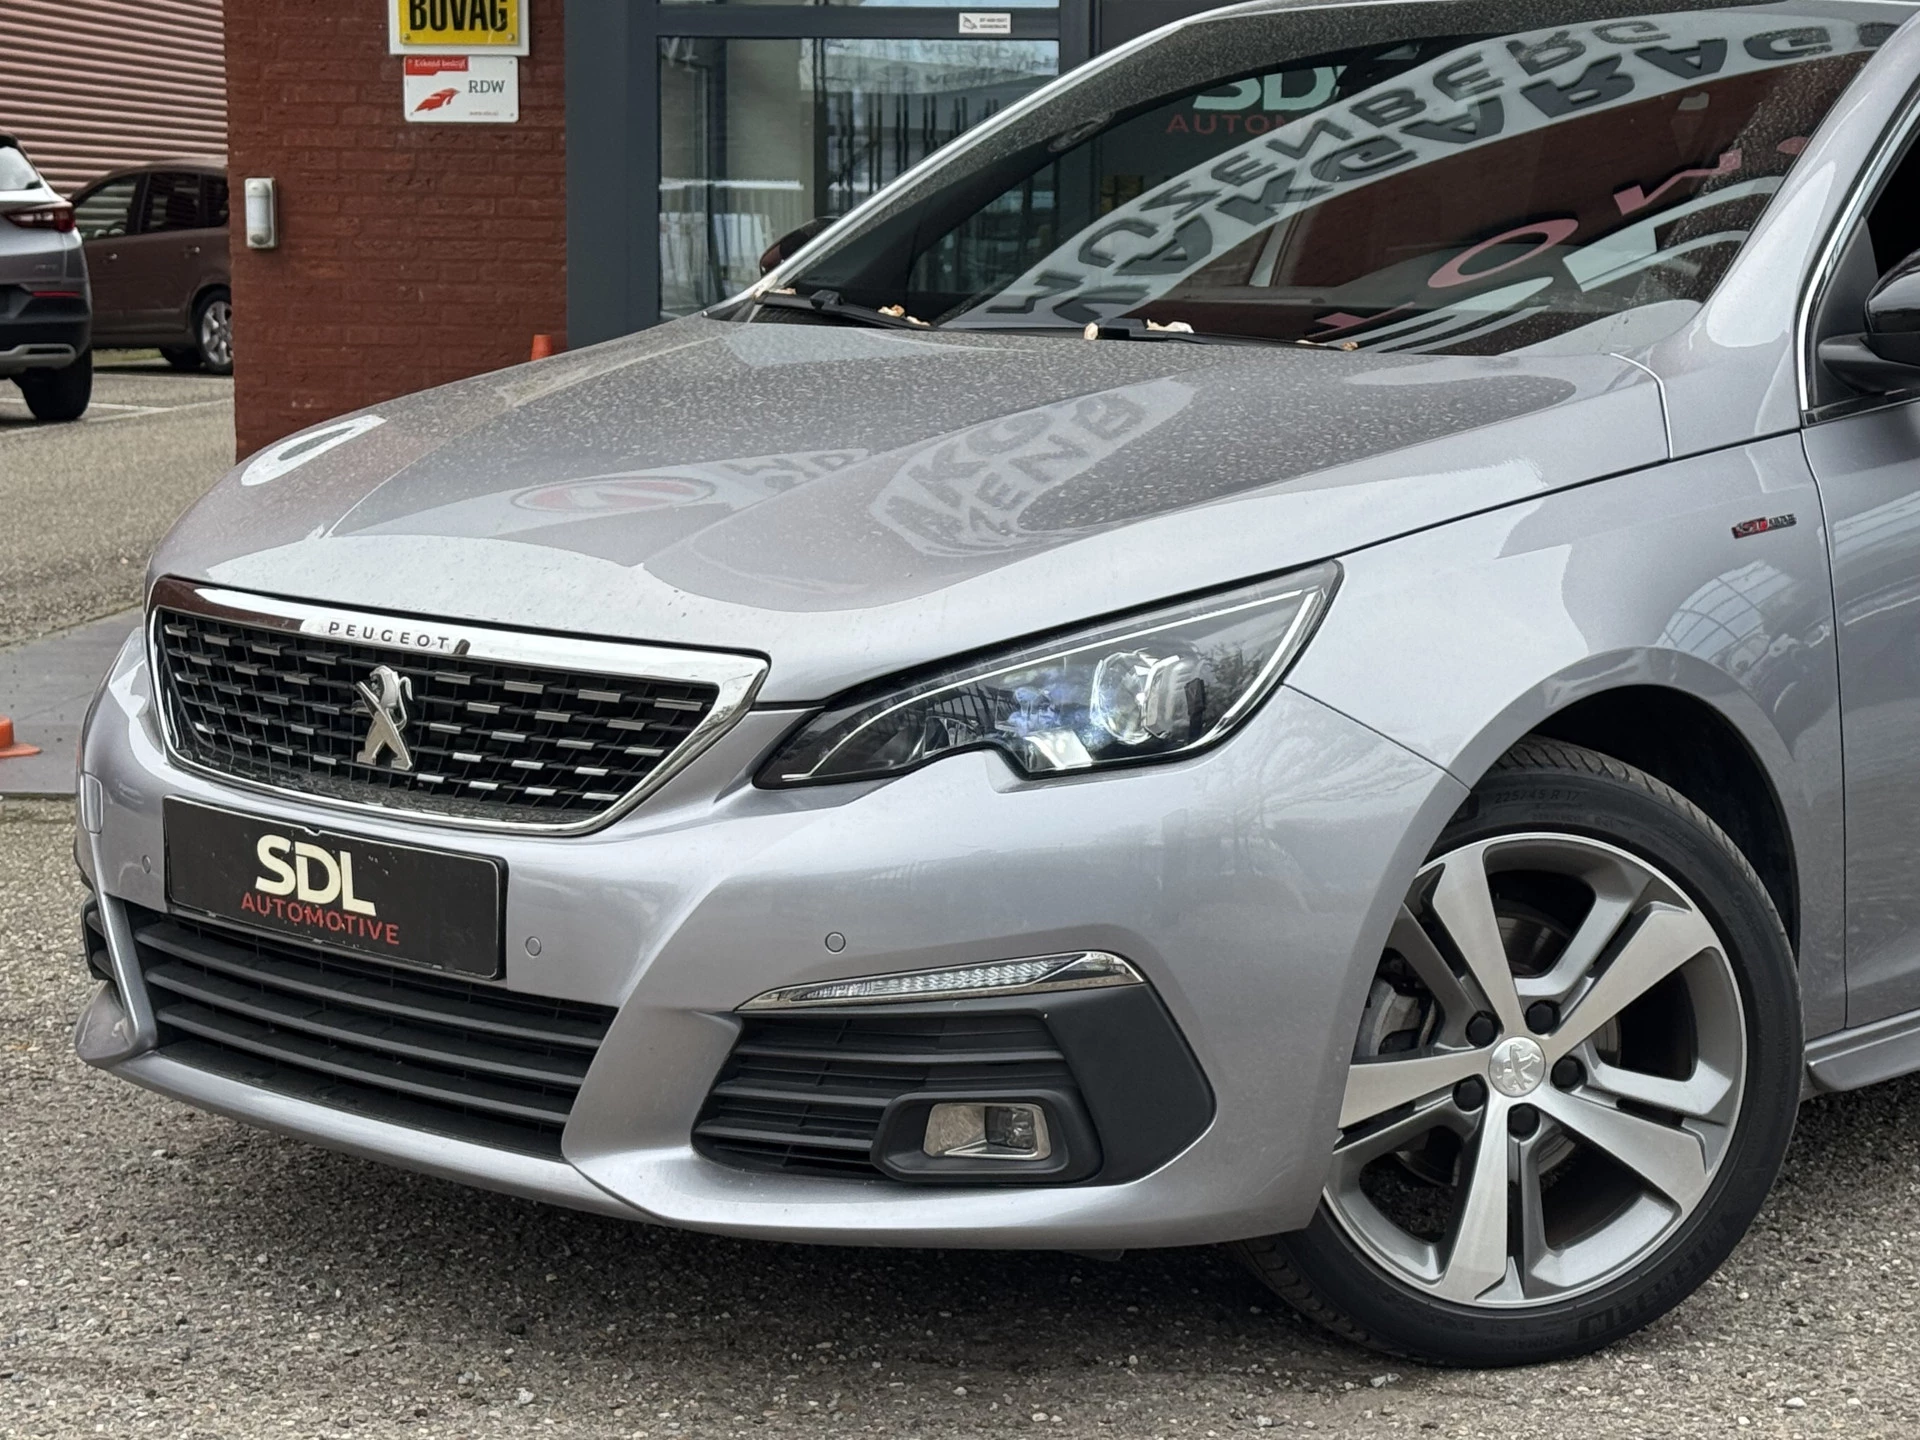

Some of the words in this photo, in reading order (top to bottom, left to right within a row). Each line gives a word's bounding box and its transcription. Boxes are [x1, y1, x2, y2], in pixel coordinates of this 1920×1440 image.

[409, 0, 509, 32] BOVAG
[468, 79, 506, 94] RDW
[328, 621, 449, 650] PEUGEOT
[255, 834, 376, 917] SDL
[241, 892, 400, 946] AUTOMOTIVE
